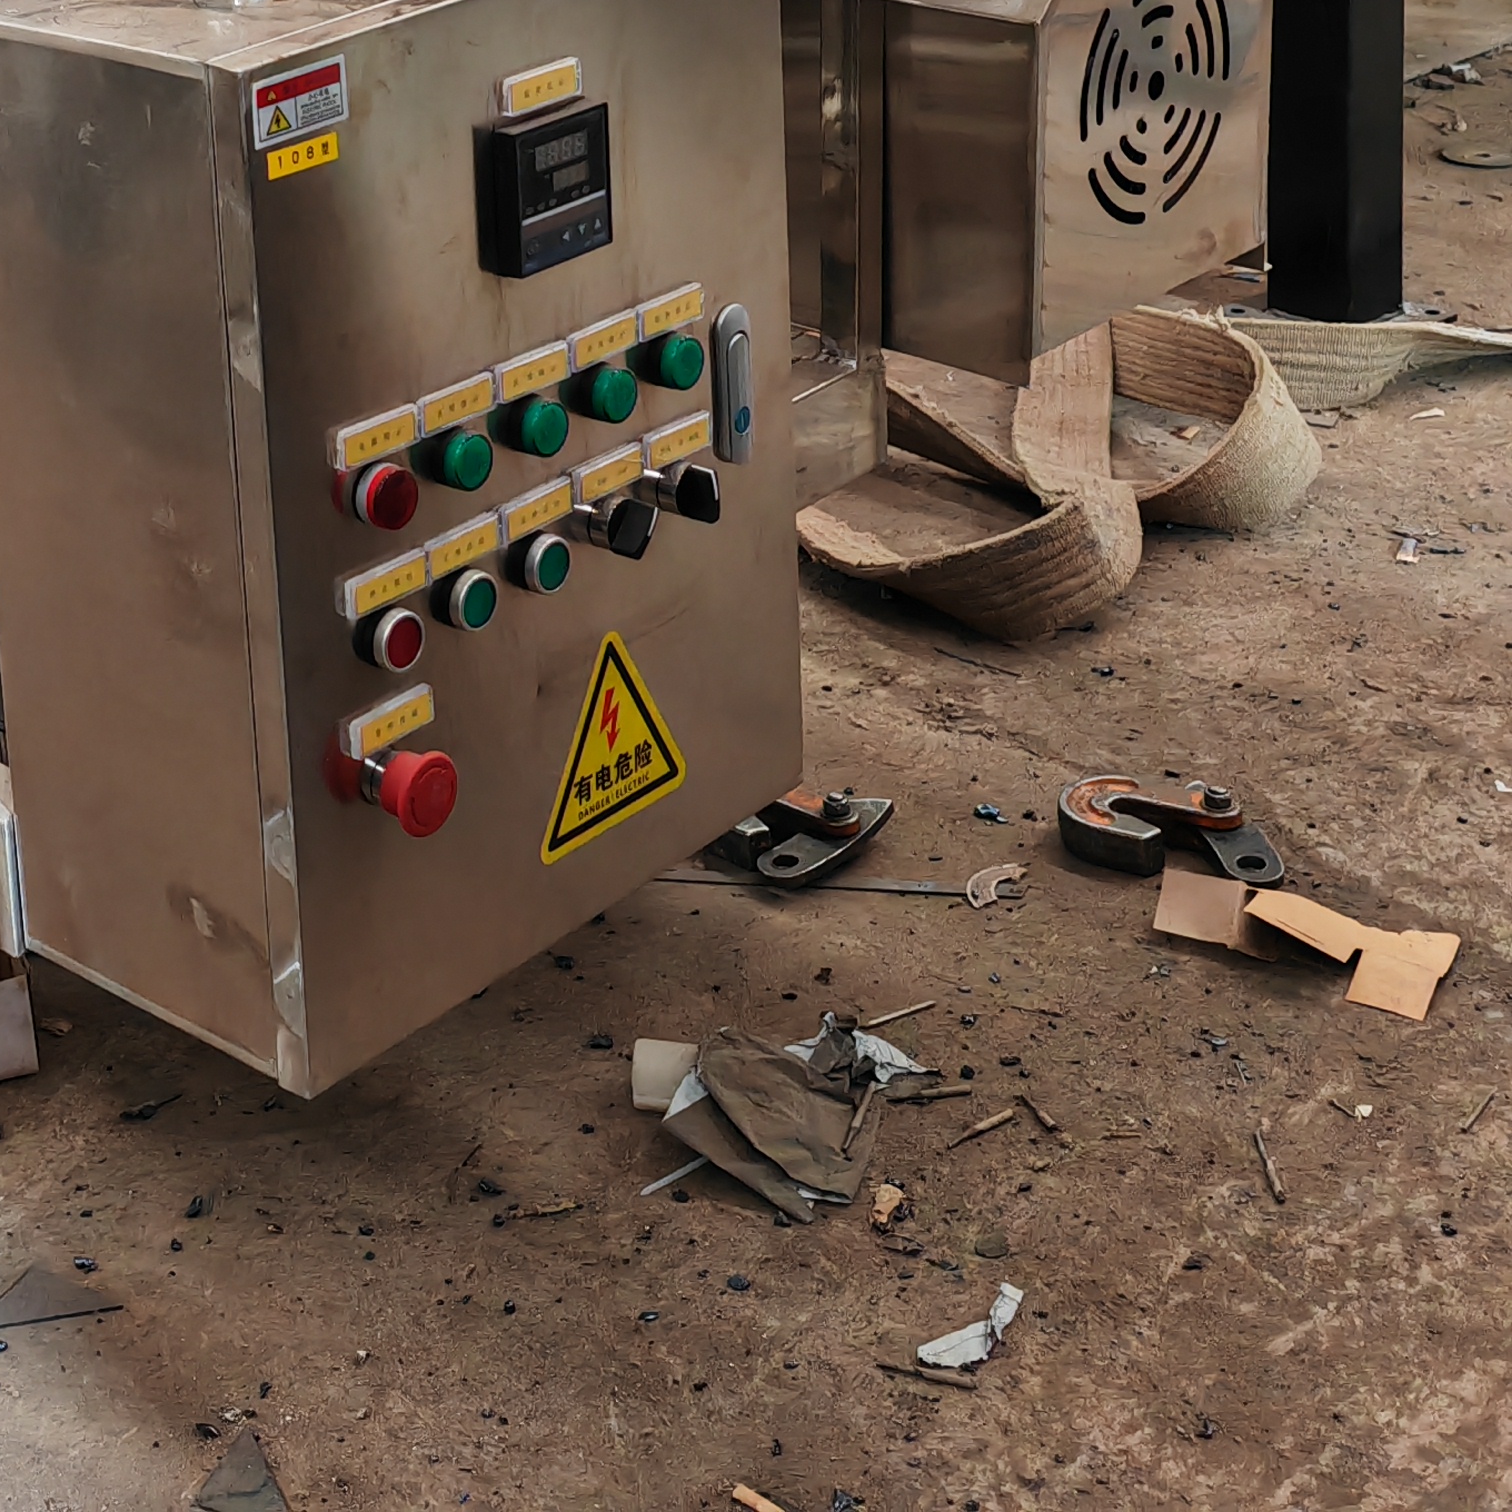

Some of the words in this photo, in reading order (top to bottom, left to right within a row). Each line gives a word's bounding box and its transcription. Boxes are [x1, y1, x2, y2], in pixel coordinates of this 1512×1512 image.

[574, 738, 653, 806] 有电危险
[578, 794, 611, 821] DANGER
[615, 770, 650, 799] ELECTRIC
